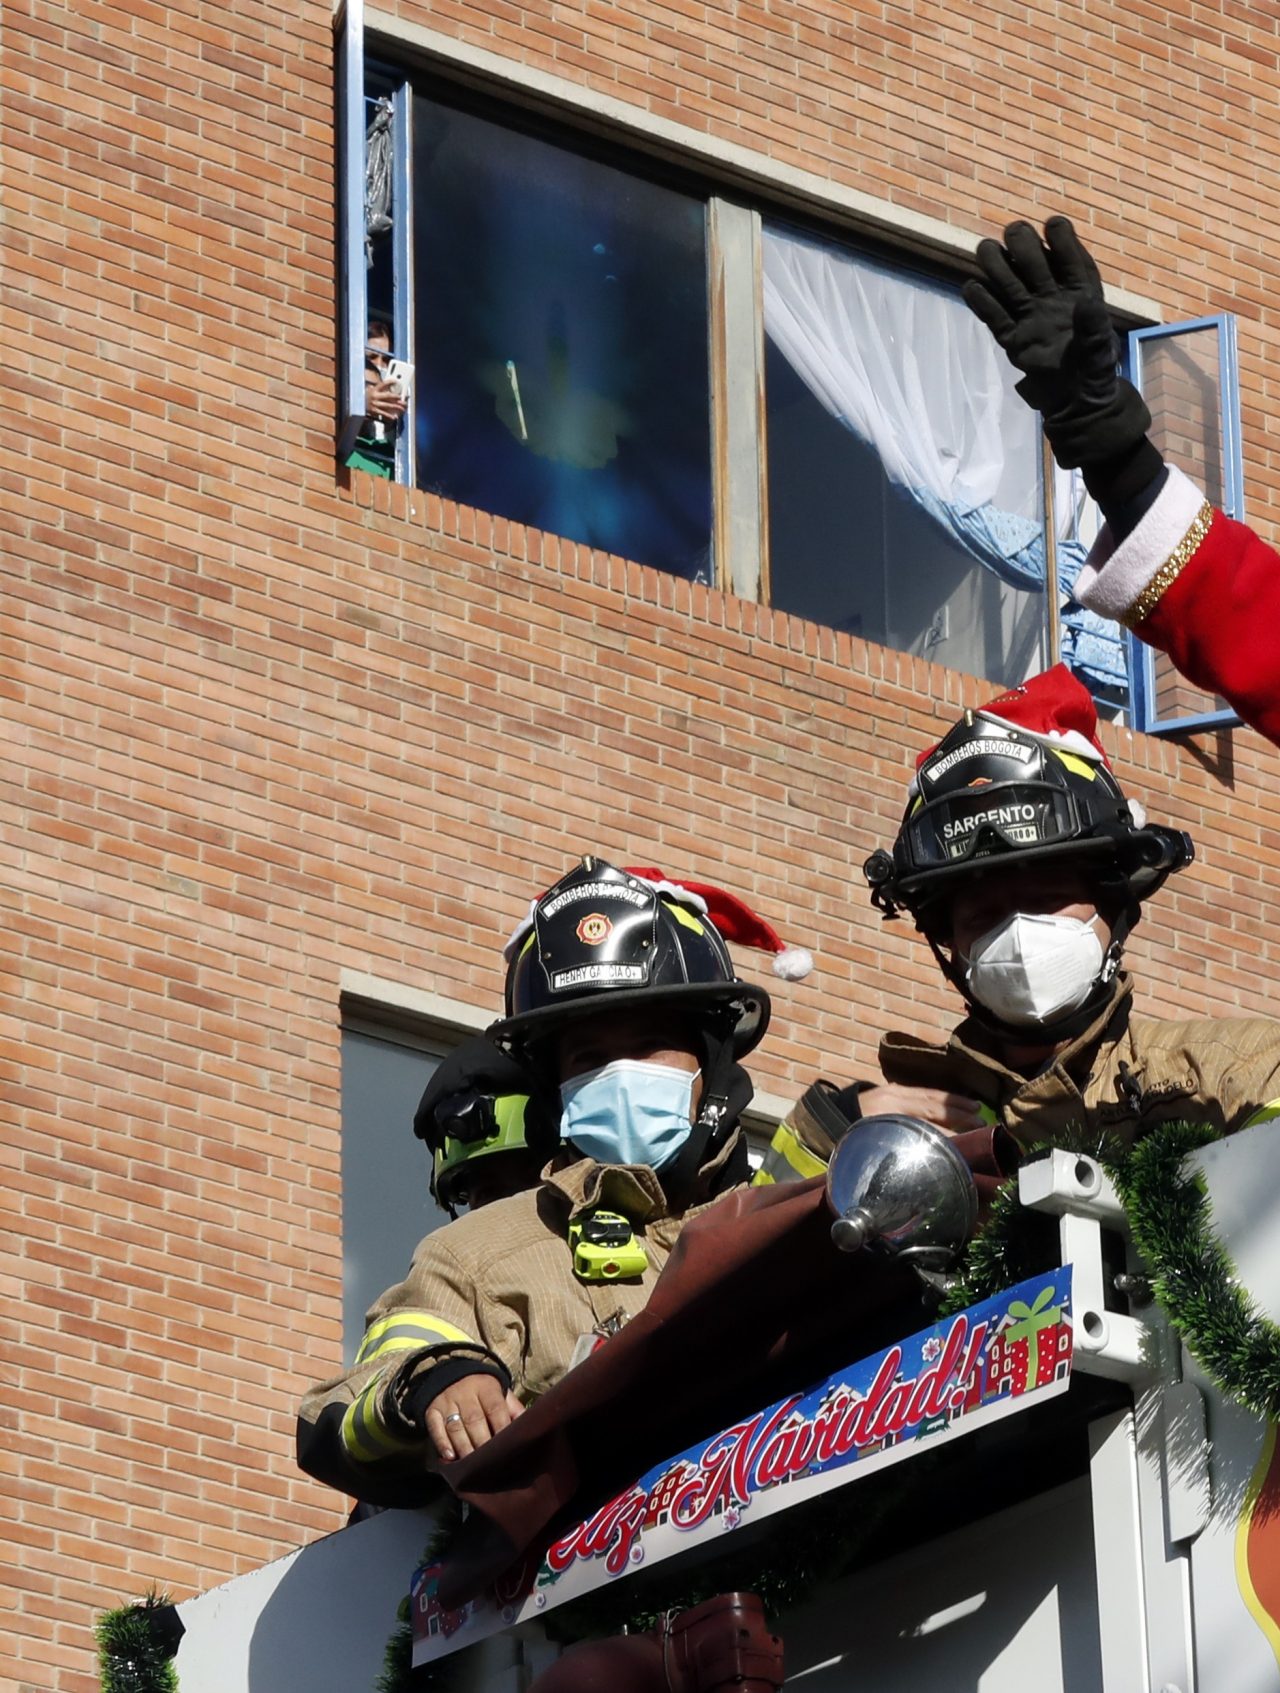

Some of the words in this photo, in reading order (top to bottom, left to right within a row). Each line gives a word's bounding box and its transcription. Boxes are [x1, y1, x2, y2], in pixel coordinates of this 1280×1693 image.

[935, 741, 981, 774] BOMBEROS
[984, 740, 1022, 757] BOGOTA
[943, 804, 1036, 839] SARGENTO
[550, 883, 599, 912] BOMBEROS
[560, 967, 587, 985] HENRY
[590, 965, 622, 978] GACIA
[668, 1314, 989, 1531] Navidad!
